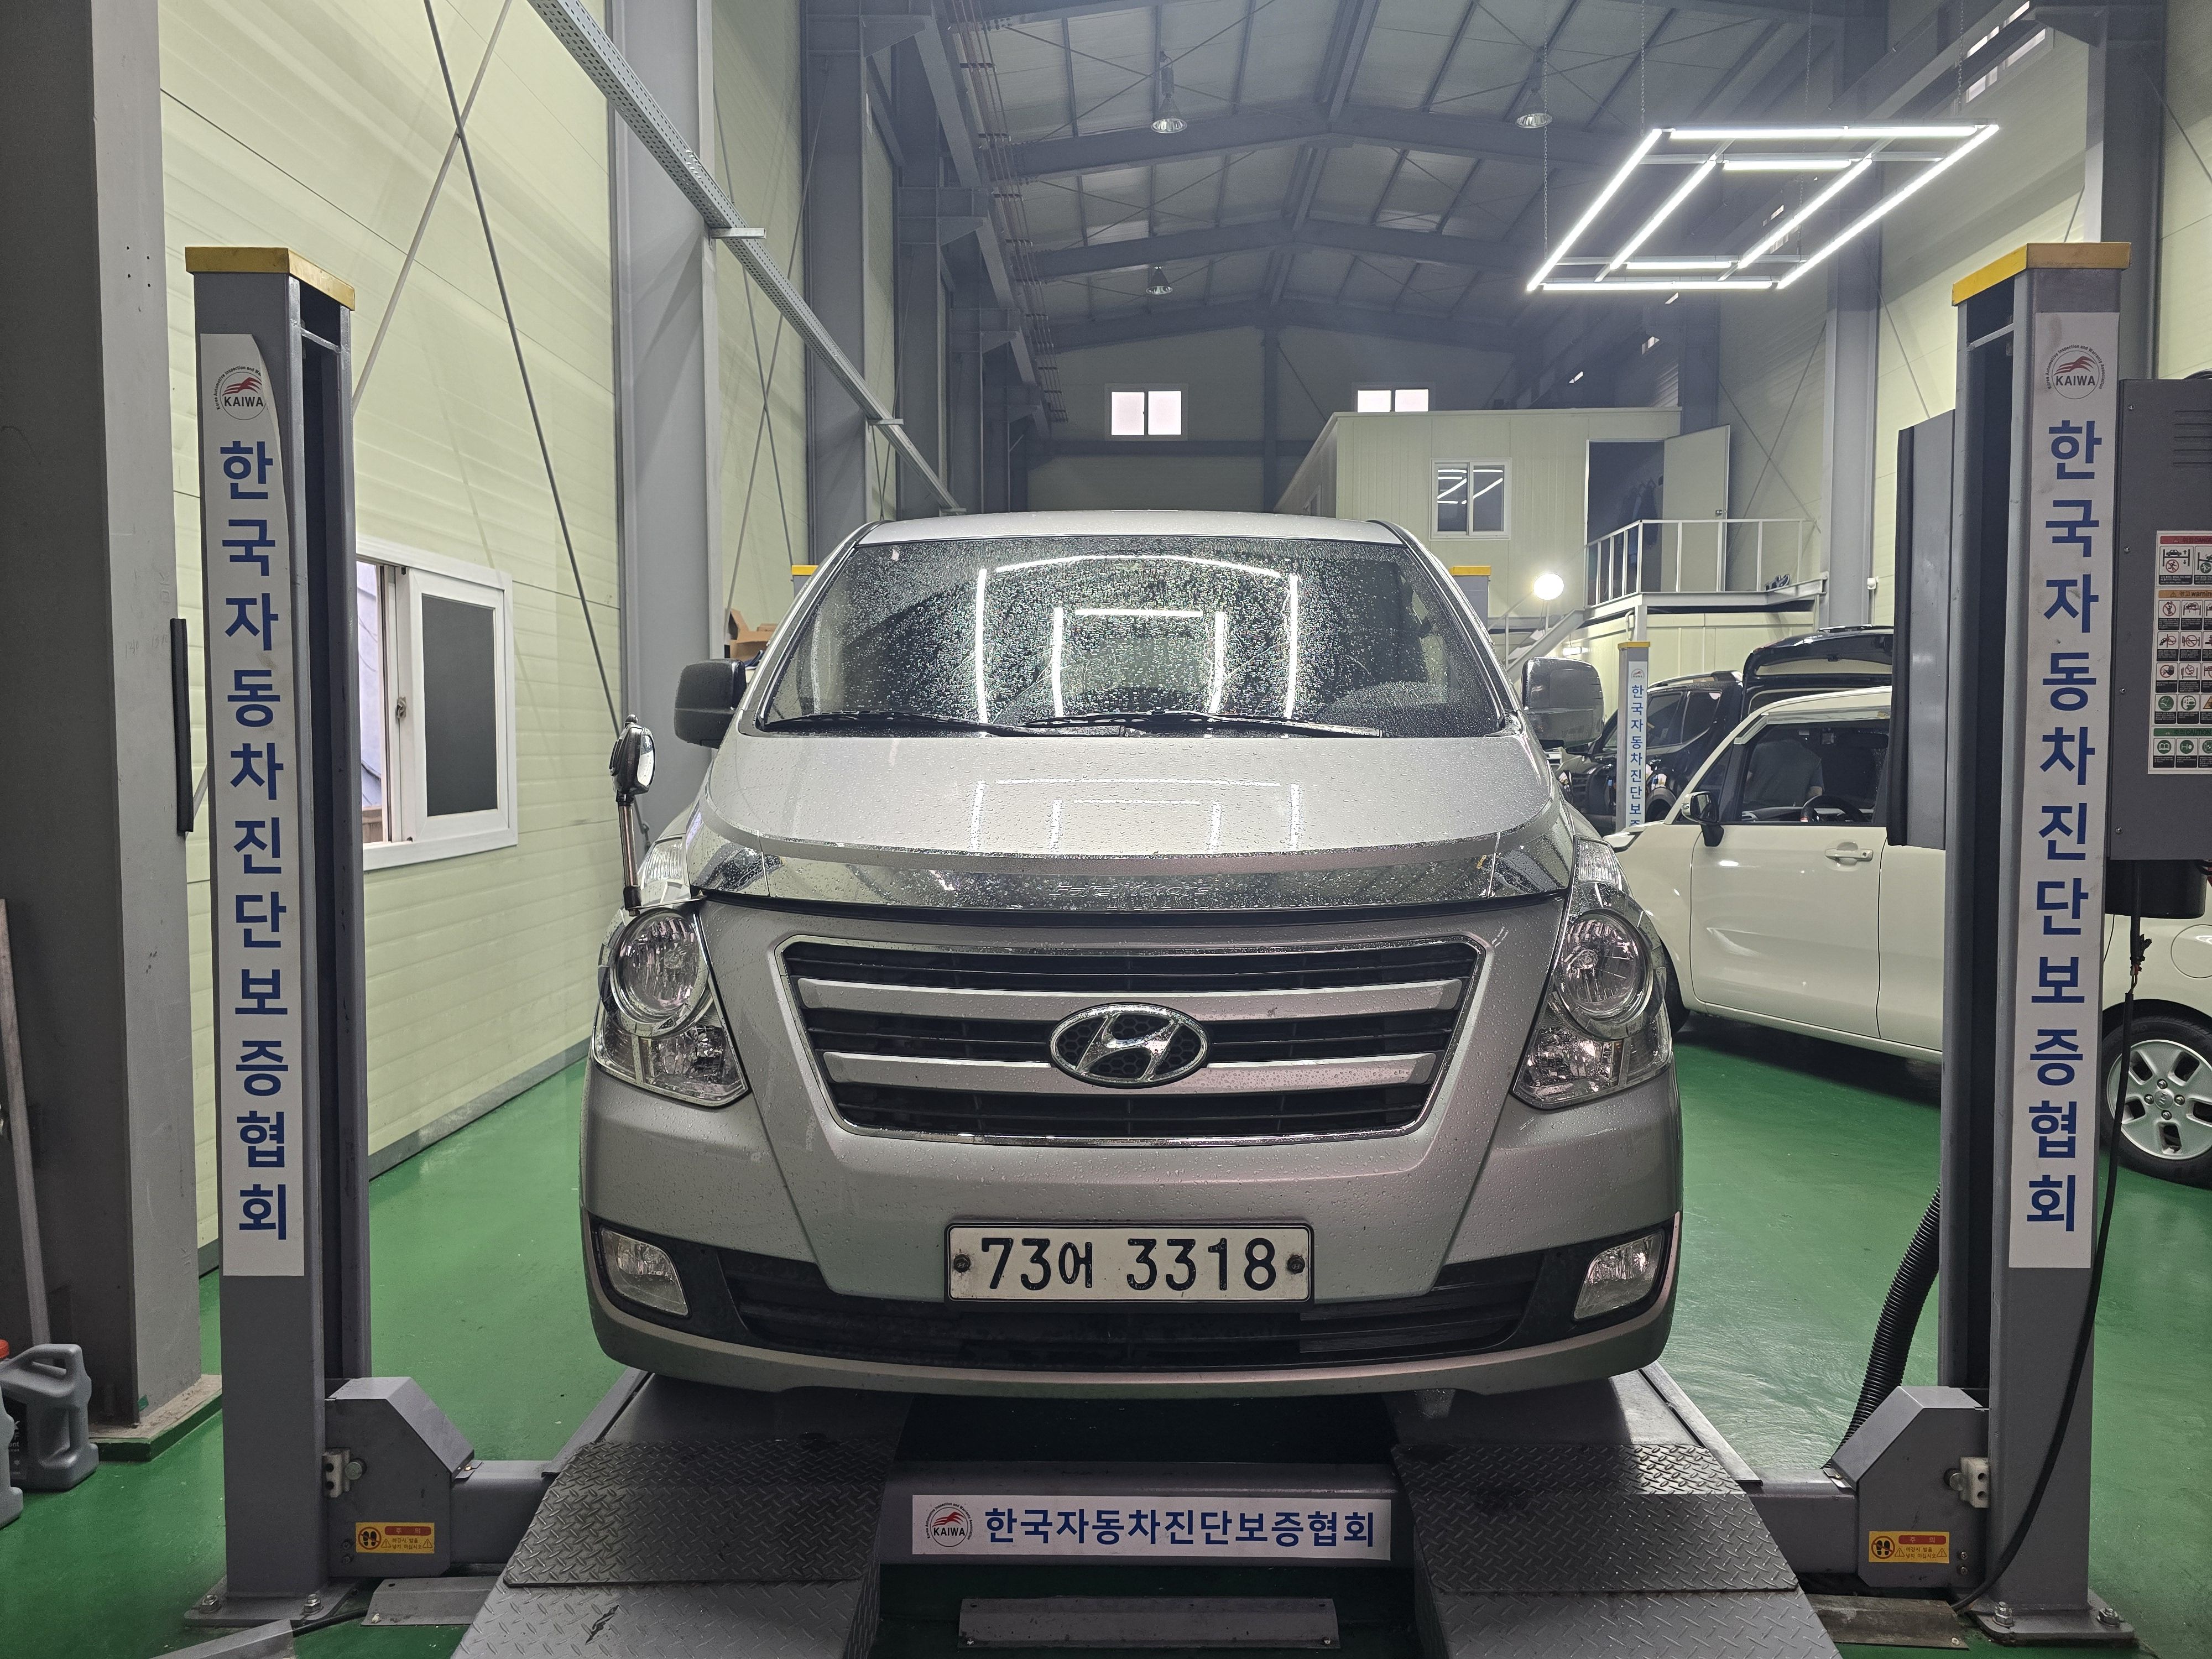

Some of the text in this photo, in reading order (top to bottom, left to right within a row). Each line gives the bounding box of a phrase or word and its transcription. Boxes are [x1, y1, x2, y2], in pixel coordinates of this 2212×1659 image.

[2046, 353, 2058, 376] Automotive
[2058, 344, 2079, 354] Inspection
[2088, 347, 2103, 363] Warranty
[213, 374, 225, 397] Automotive
[225, 366, 246, 375] Inspection
[2056, 375, 2096, 386] KAIWA
[224, 396, 264, 407] KAIWA
[220, 440, 289, 1240] 한국자동차진단보증협회
[2027, 420, 2102, 1232] 한국자동차진단보증협회
[981, 1237, 1277, 1291] 73어 3318
[959, 1505, 971, 1519] Warranty
[984, 1507, 1374, 1547] 한국자동차진단보증협회
[933, 1527, 966, 1536] KAIWA
